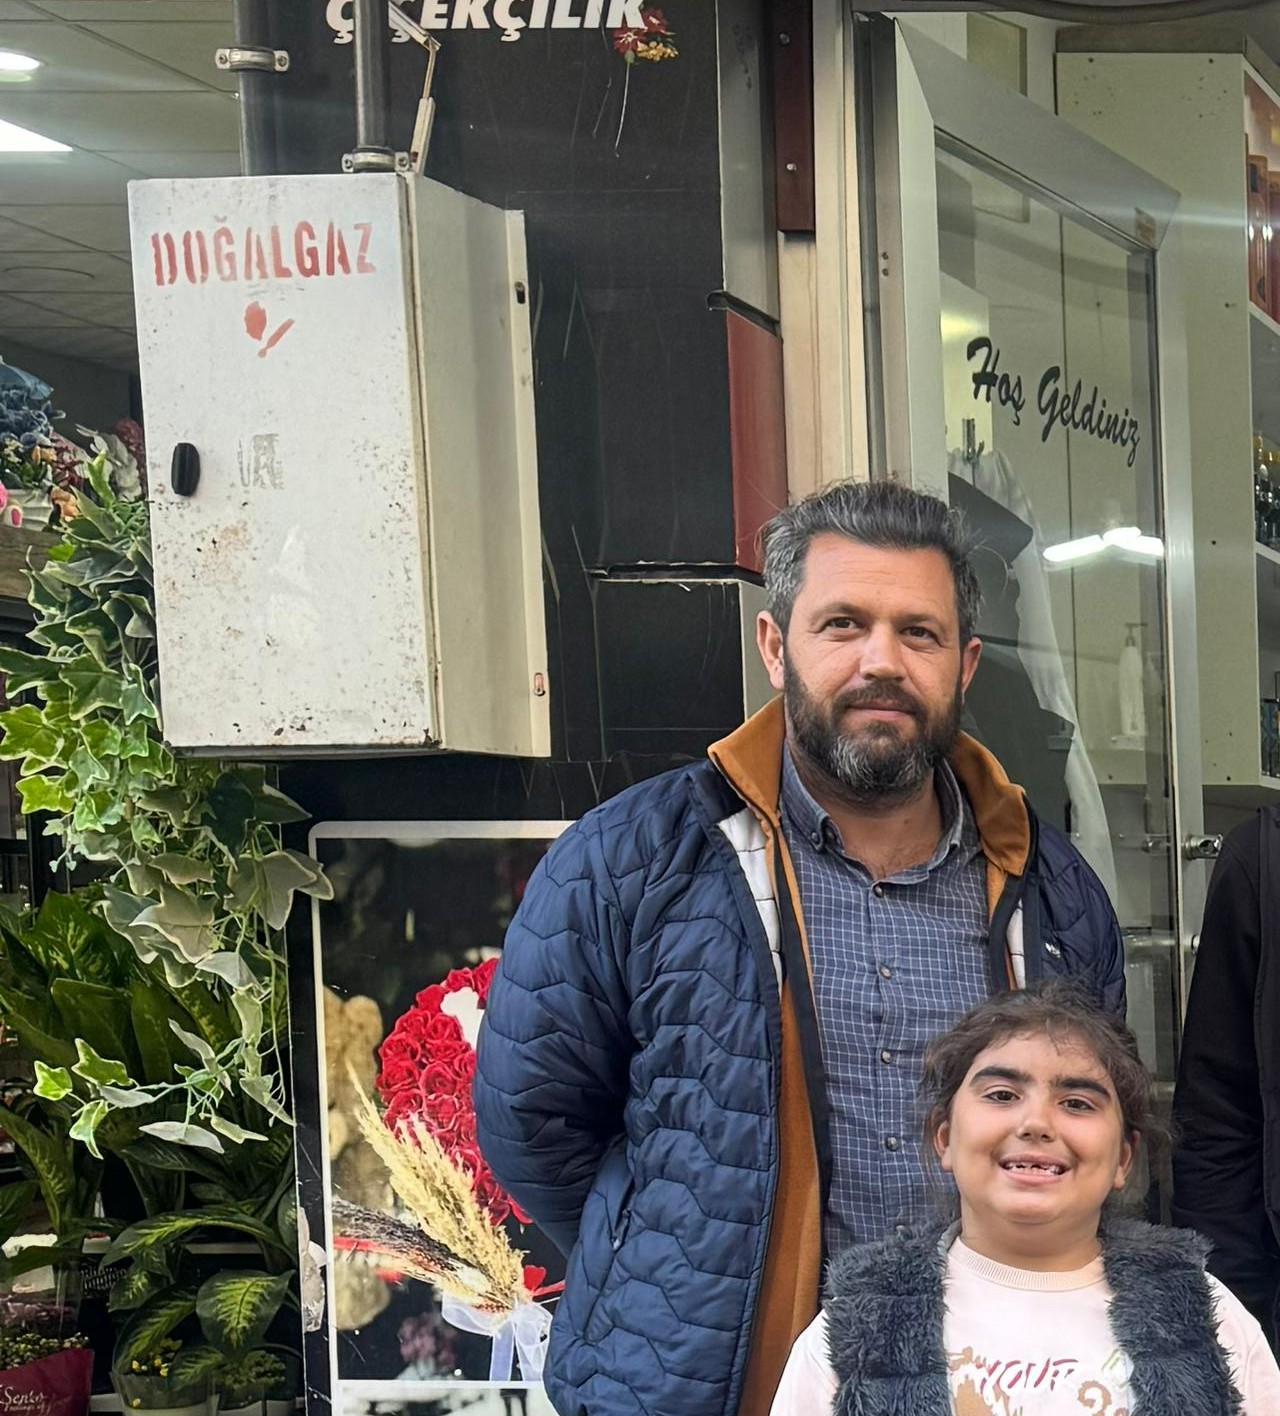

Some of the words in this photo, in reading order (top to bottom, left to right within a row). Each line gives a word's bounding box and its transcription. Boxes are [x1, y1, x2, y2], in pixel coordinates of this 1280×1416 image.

[152, 215, 376, 286] DOĞALGAZ
[967, 337, 1025, 426] Hoş
[1038, 366, 1141, 468] Geldiniz
